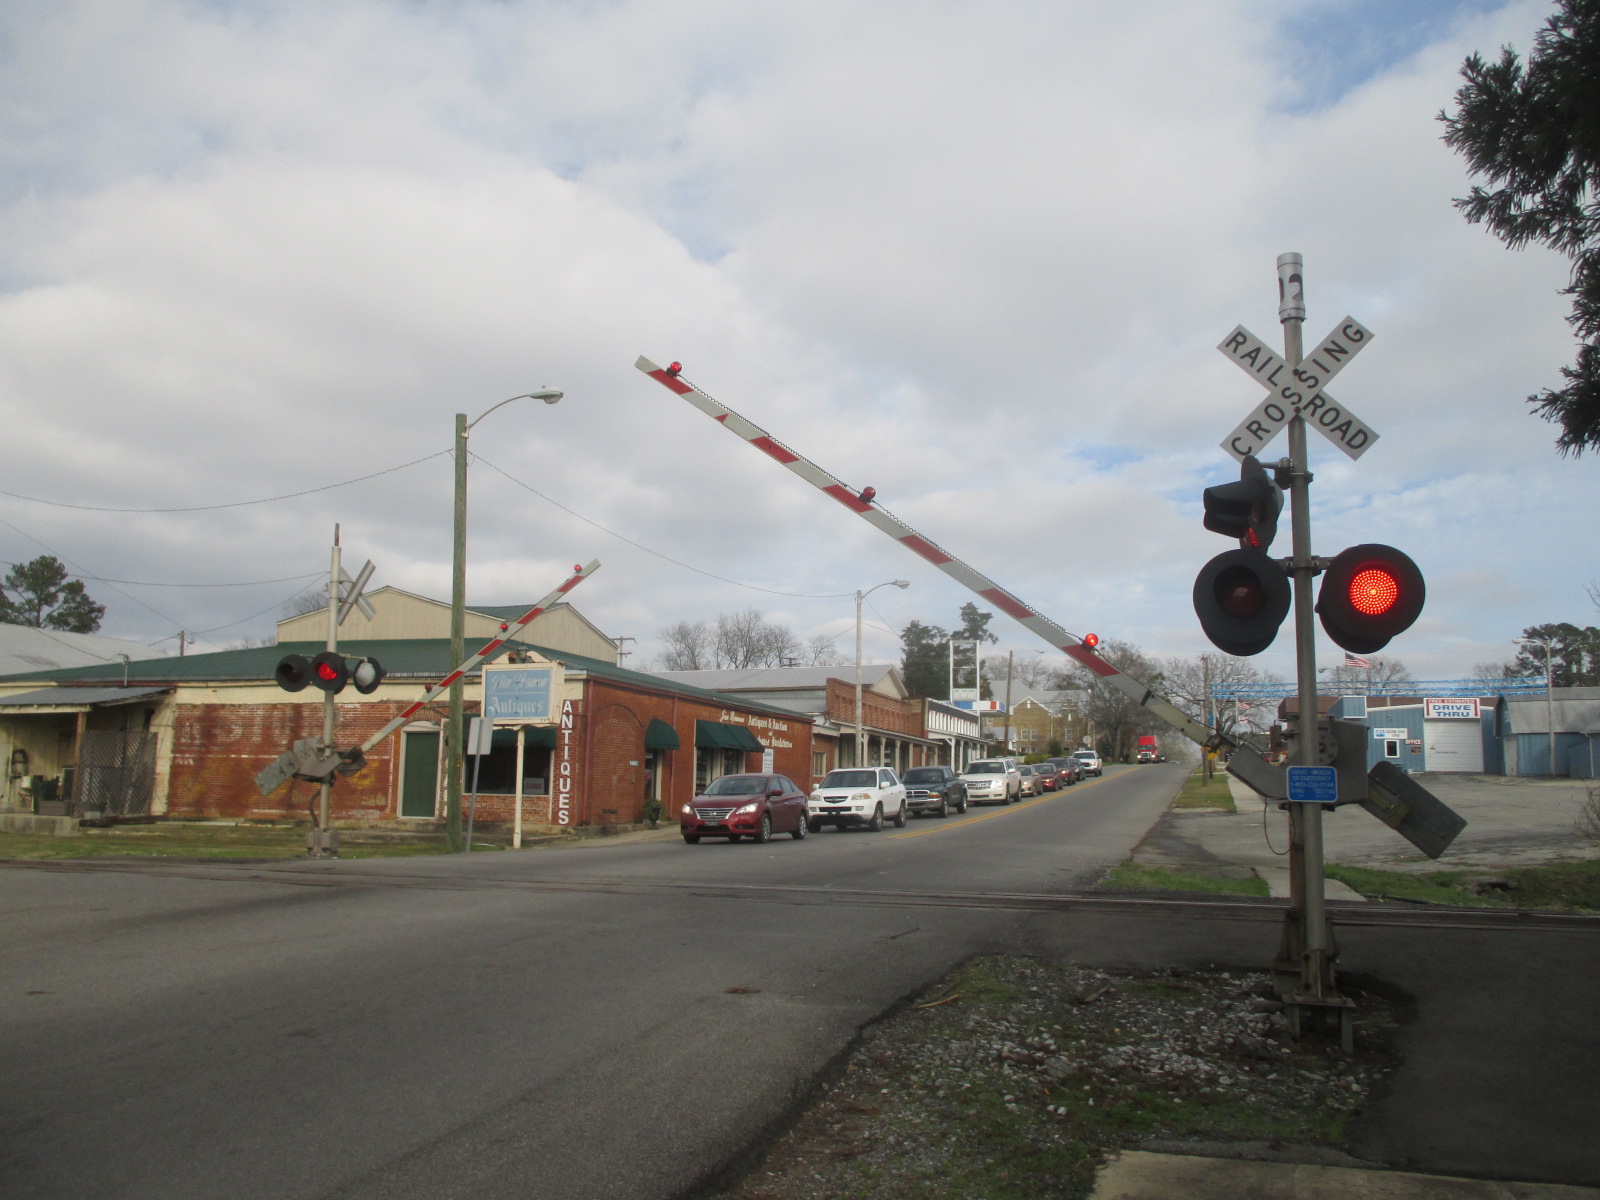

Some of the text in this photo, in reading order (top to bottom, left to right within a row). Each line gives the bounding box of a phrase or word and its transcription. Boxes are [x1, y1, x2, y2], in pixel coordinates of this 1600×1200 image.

[1231, 324, 1364, 456] CROSSING
[488, 696, 544, 716] Antiques
[558, 700, 573, 825] ANTIQUES
